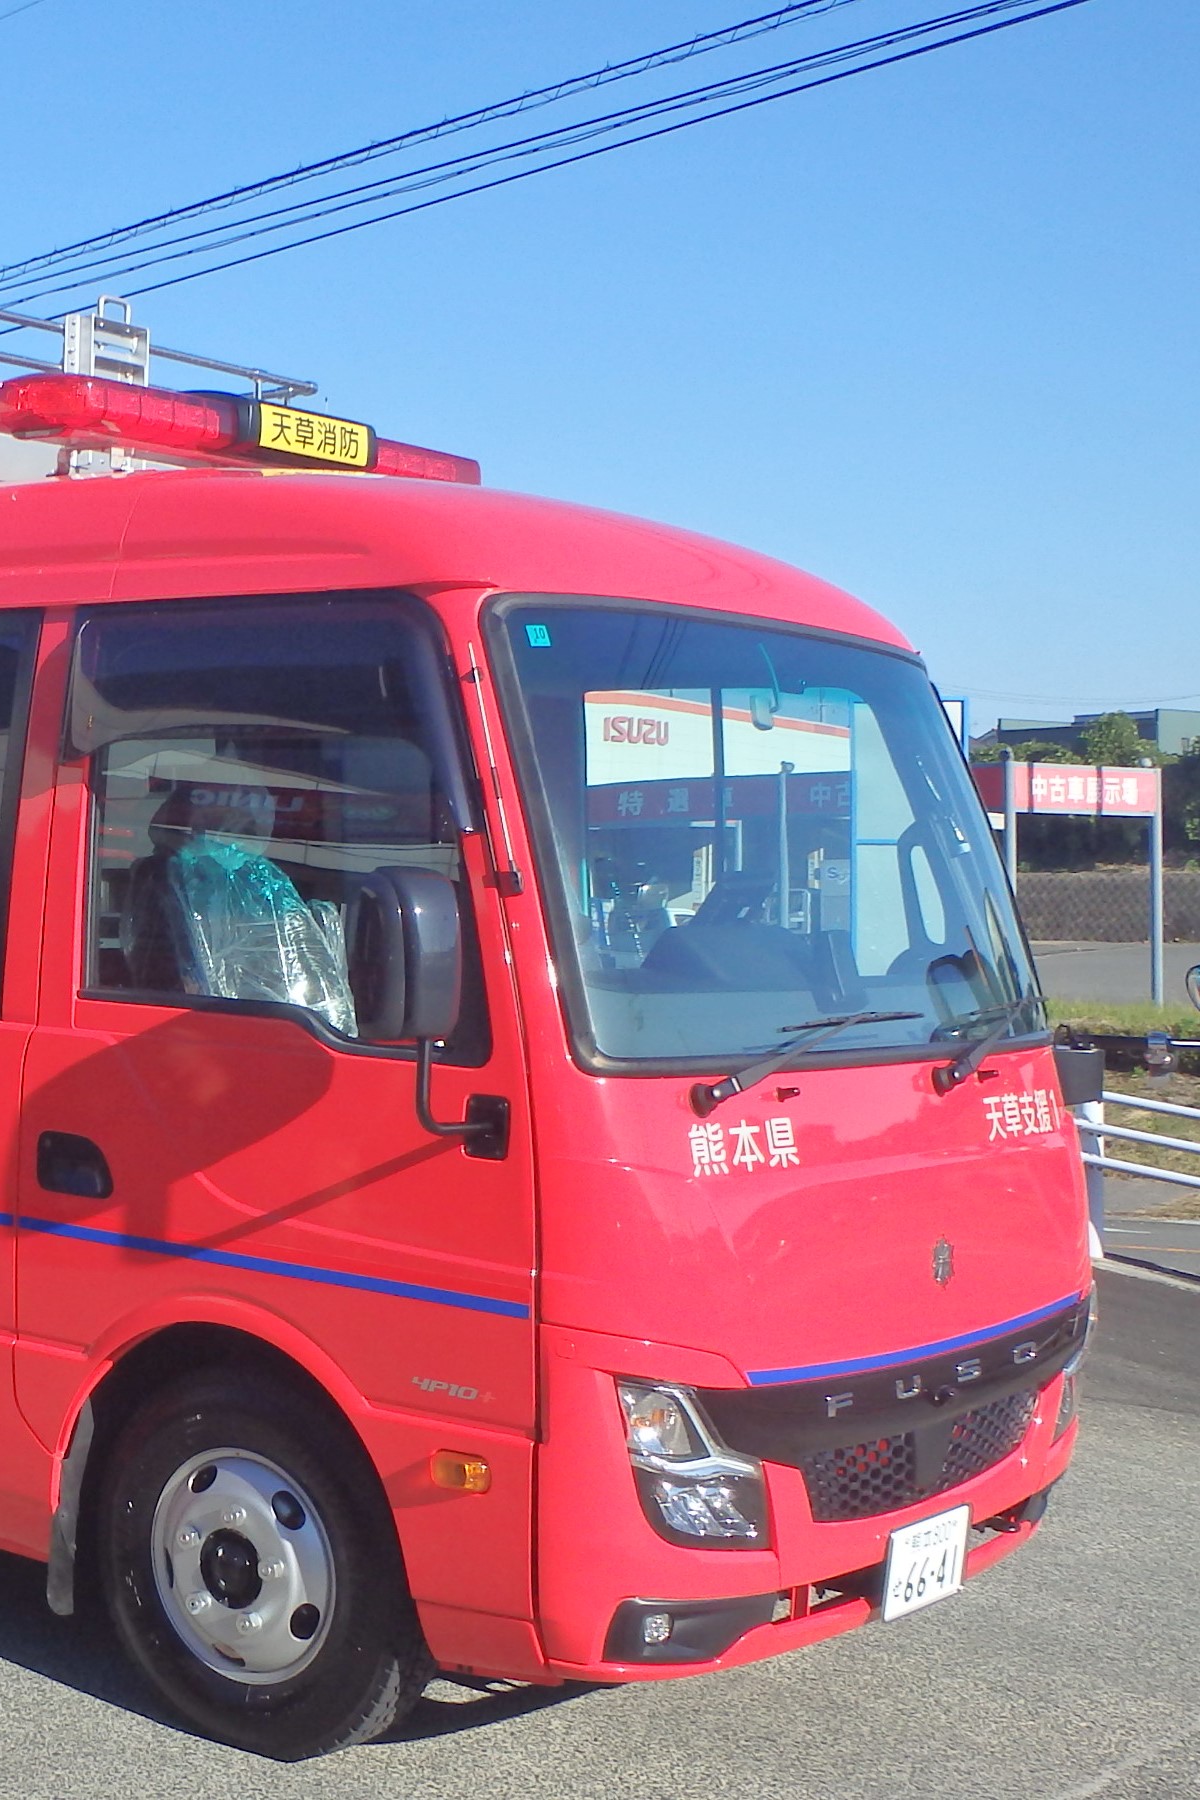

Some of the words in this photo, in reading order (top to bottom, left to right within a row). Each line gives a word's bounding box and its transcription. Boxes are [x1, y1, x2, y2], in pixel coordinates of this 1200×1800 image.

[271, 410, 360, 459] 天草消防
[533, 627, 546, 639] 10
[603, 716, 669, 746] ISUZU
[1031, 774, 1139, 806] 中古車展示場
[688, 1117, 801, 1178] 熊本県
[824, 1341, 1038, 1417] FUSO
